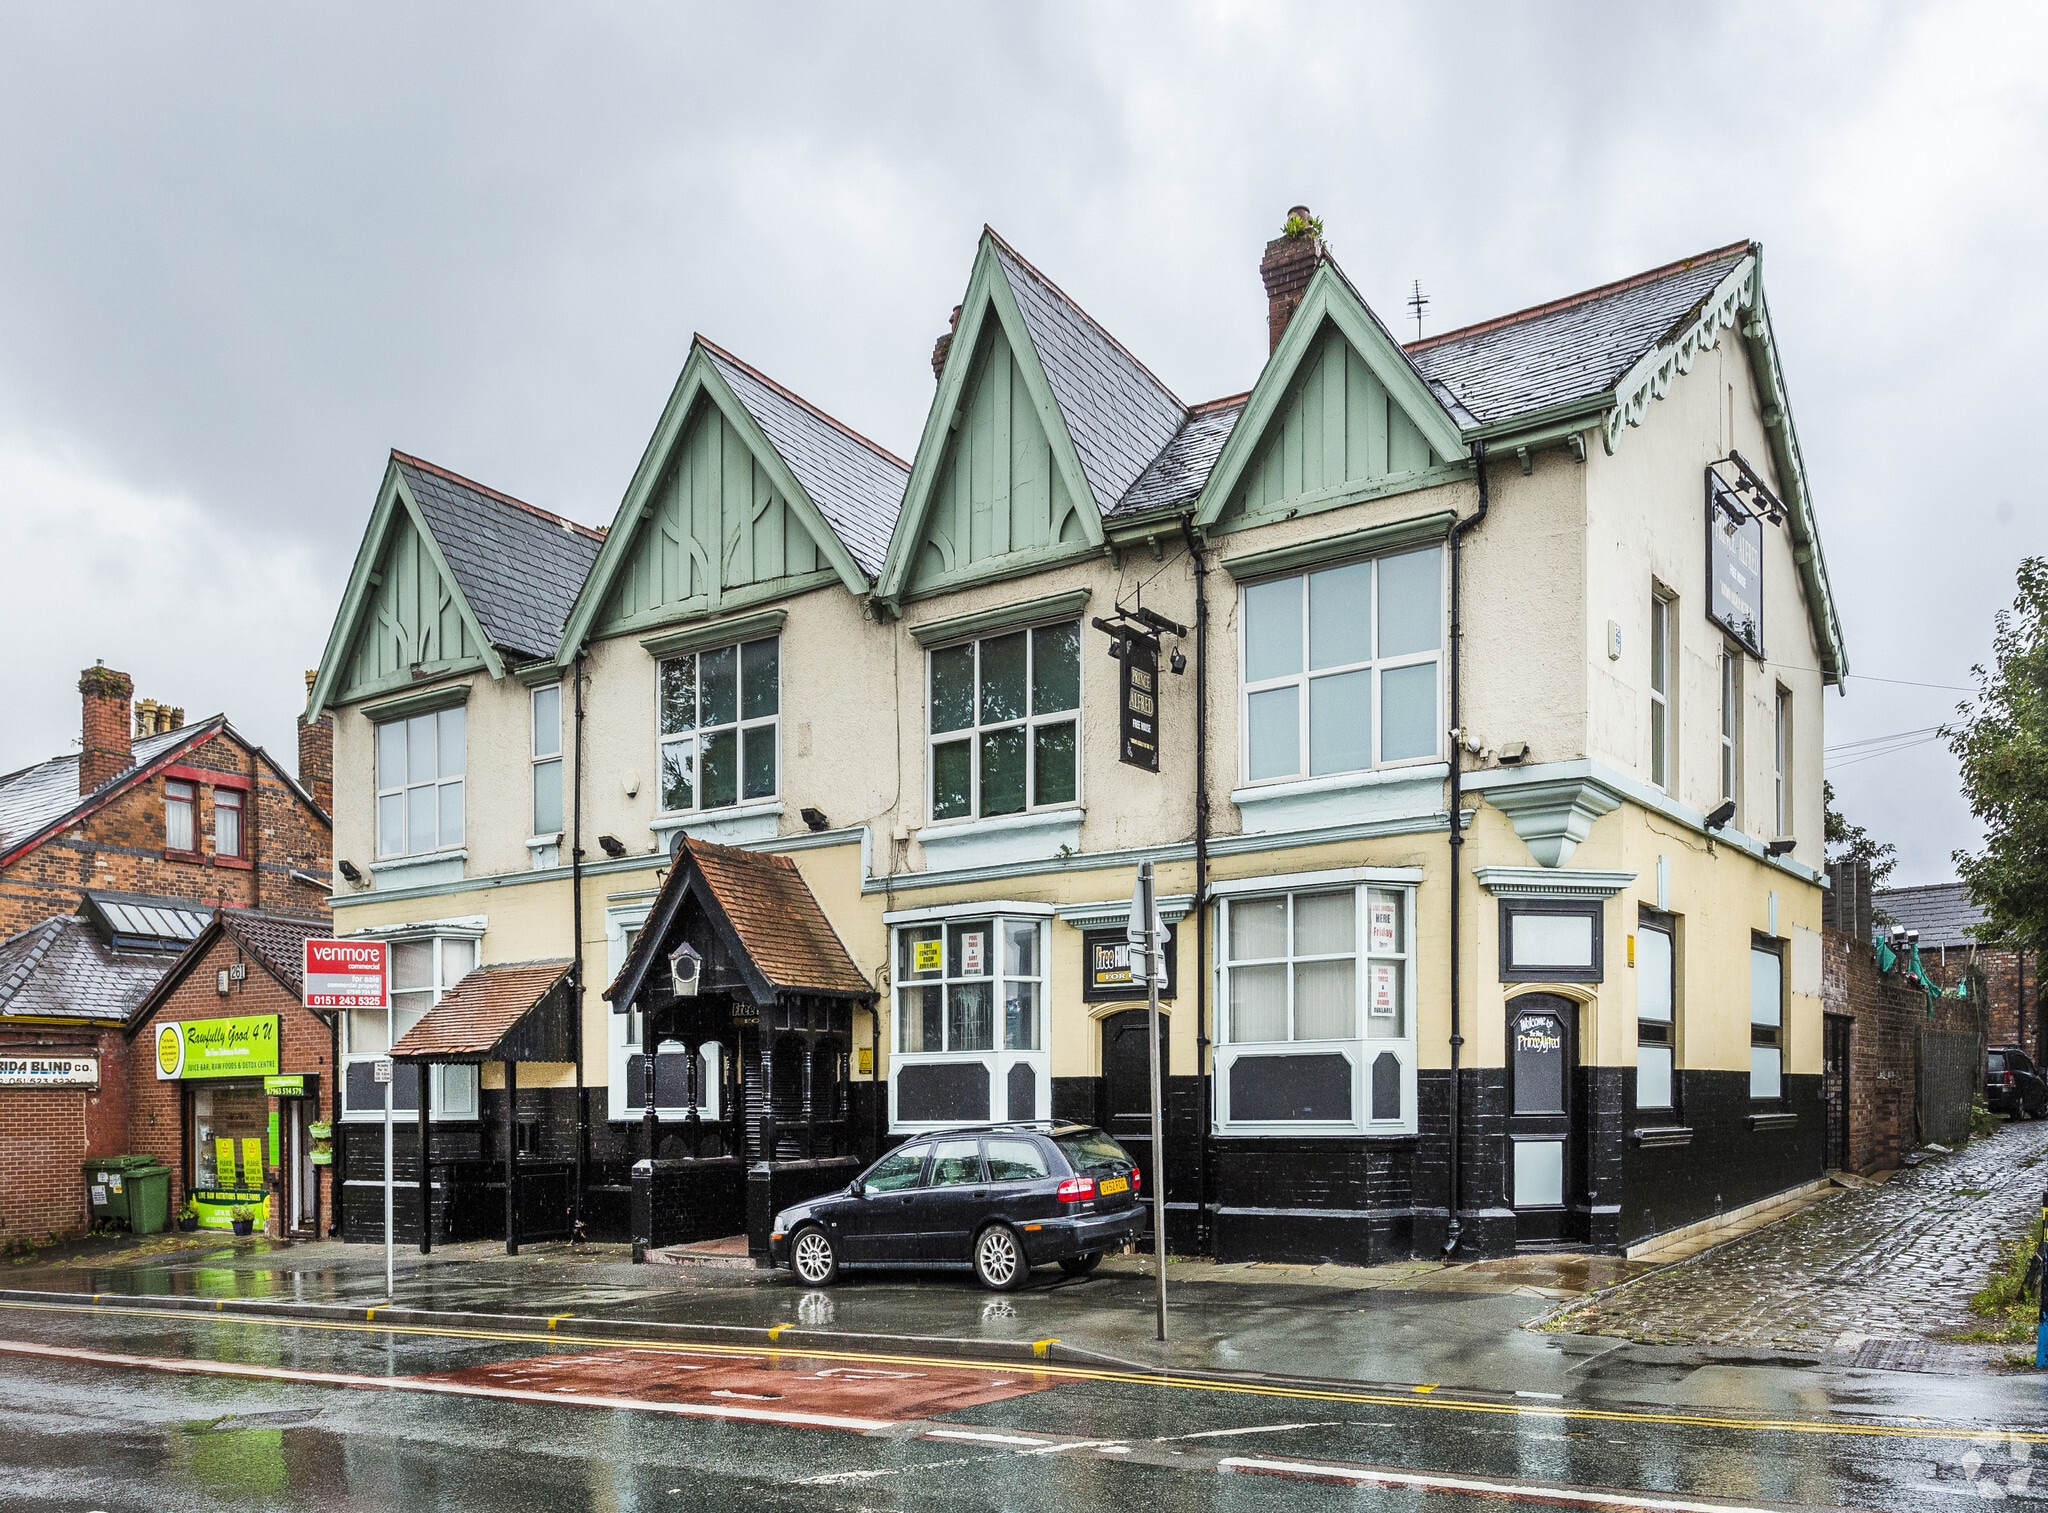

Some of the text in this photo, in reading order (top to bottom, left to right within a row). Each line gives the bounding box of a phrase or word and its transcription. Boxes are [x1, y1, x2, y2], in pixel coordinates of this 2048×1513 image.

[1739, 533, 1758, 577] ALFRED
[1132, 668, 1151, 691] PRINCE
[1130, 691, 1153, 715] ALFRED
[1375, 914, 1391, 924] HERE
[1373, 927, 1393, 938] Friday
[313, 947, 380, 962] venmore
[919, 949, 937, 957] FUNCTION
[1096, 946, 1114, 969] Free
[231, 964, 244, 978] 261
[919, 962, 938, 970] AVAILABLE
[352, 974, 380, 983] for sale
[314, 996, 380, 1006] 0151 243 5325
[732, 1003, 754, 1016] Free
[1520, 1017, 1553, 1031] Welcome to
[187, 1022, 273, 1048] Rawfully Good 4 U
[31, 1061, 72, 1071] BLIND
[74, 1064, 92, 1072] CO.
[212, 1062, 221, 1070] RAW
[222, 1061, 237, 1069] FOODS
[242, 1061, 257, 1069] DETOX
[258, 1060, 275, 1068] CENTRE
